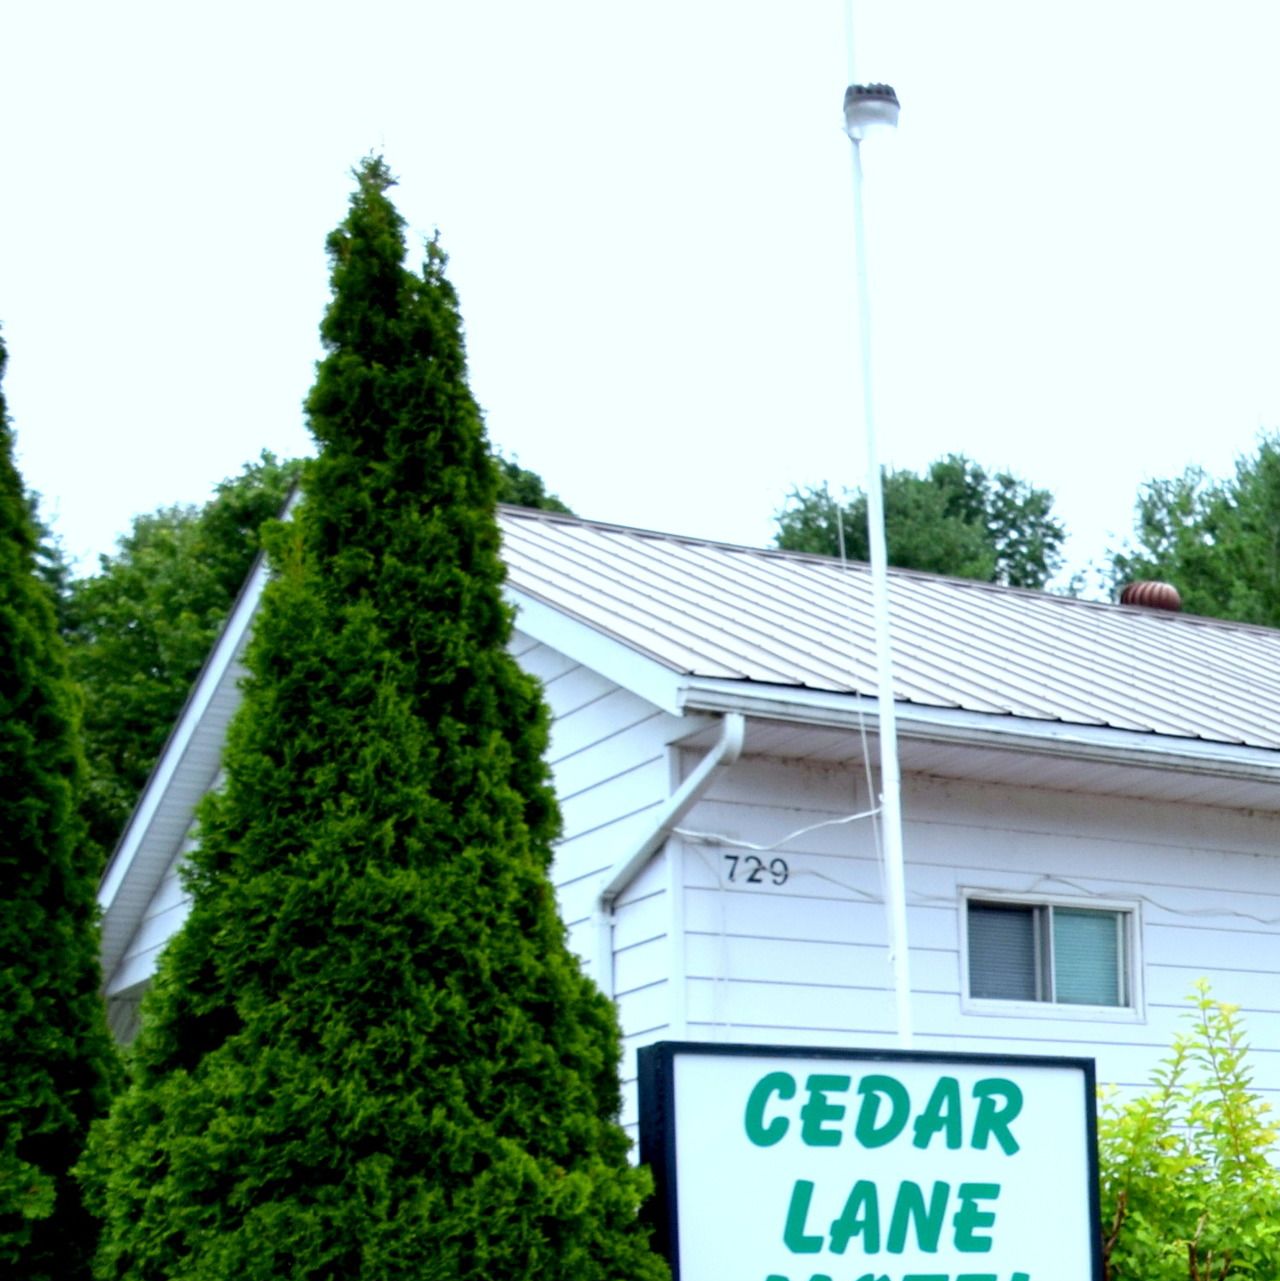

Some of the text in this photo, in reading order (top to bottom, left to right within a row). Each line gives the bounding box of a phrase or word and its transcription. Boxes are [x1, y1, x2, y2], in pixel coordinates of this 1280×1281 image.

[724, 854, 789, 886] 729
[744, 1071, 1024, 1156] CEDAR
[783, 1178, 1001, 1255] LANE
